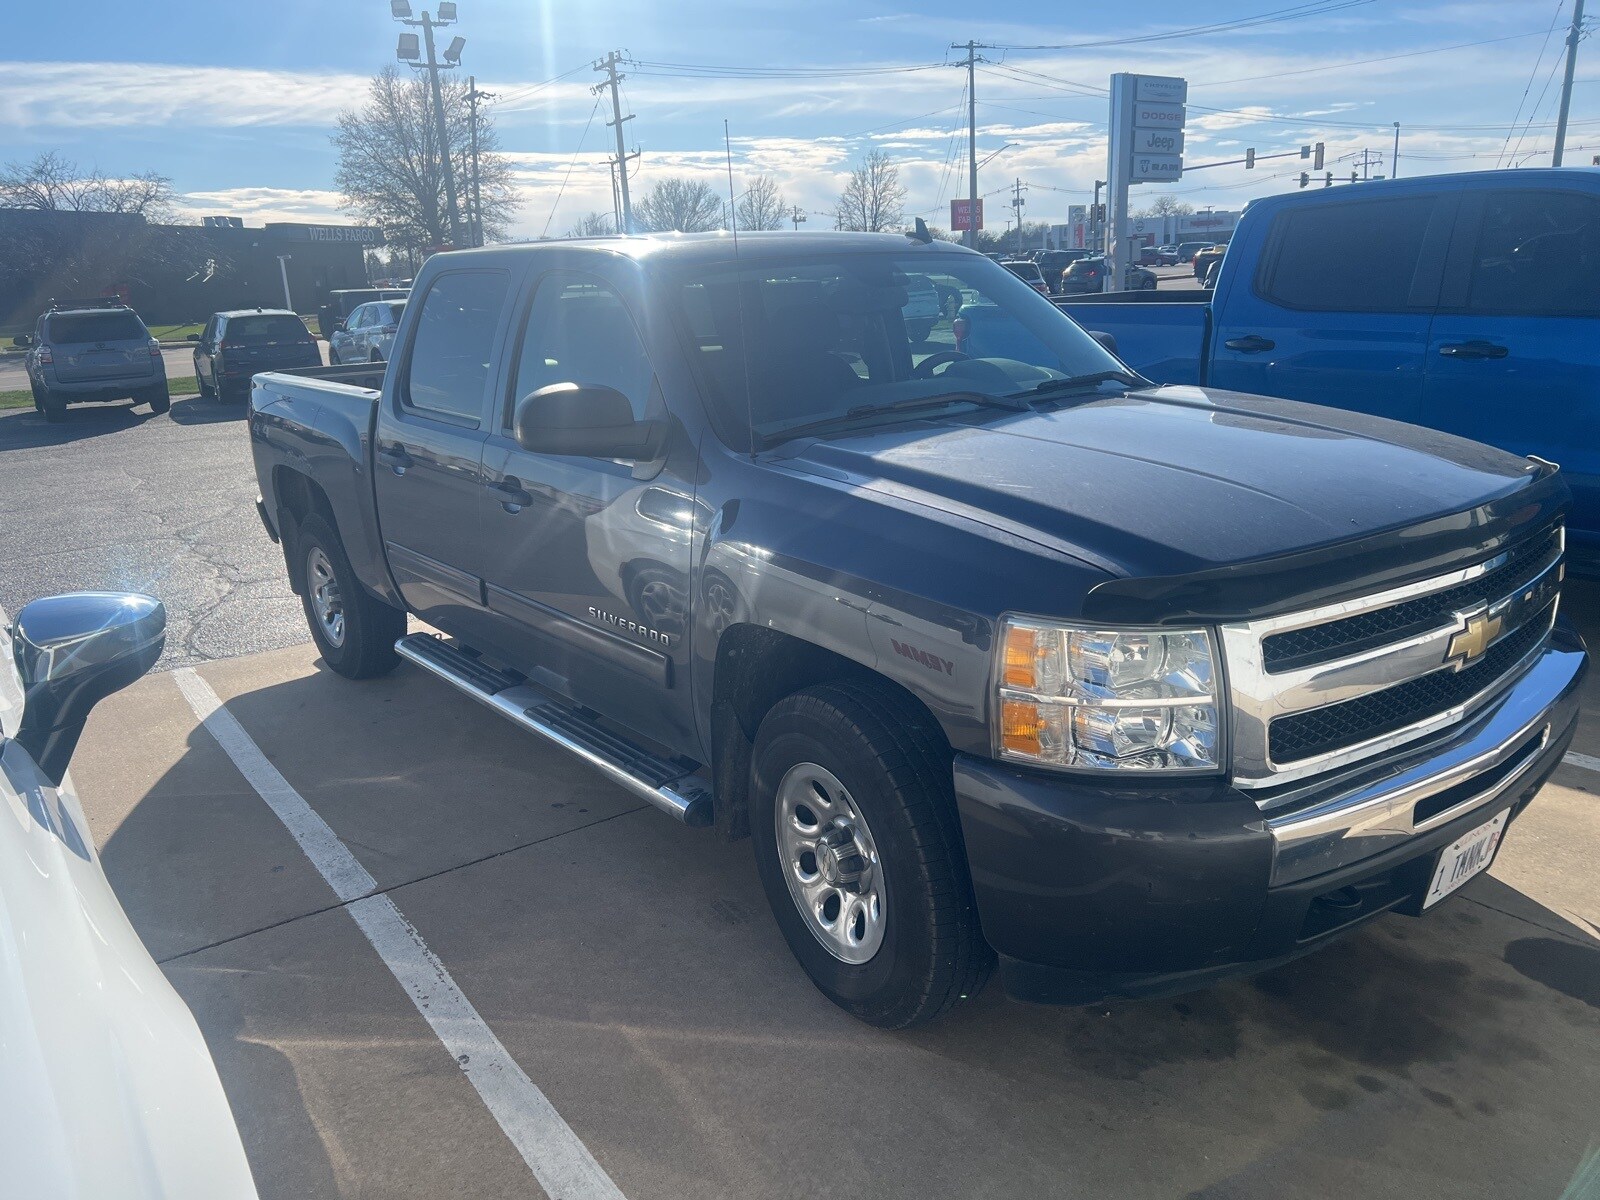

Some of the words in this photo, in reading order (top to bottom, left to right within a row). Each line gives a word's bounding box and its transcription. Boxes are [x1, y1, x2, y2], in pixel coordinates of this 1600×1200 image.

[1142, 112, 1181, 120] DODGE
[1147, 133, 1174, 151] Jeep
[1151, 163, 1178, 172] RAM
[309, 227, 343, 241] WELLS
[345, 229, 374, 241] FARGO
[588, 606, 669, 646] SILVERADO
